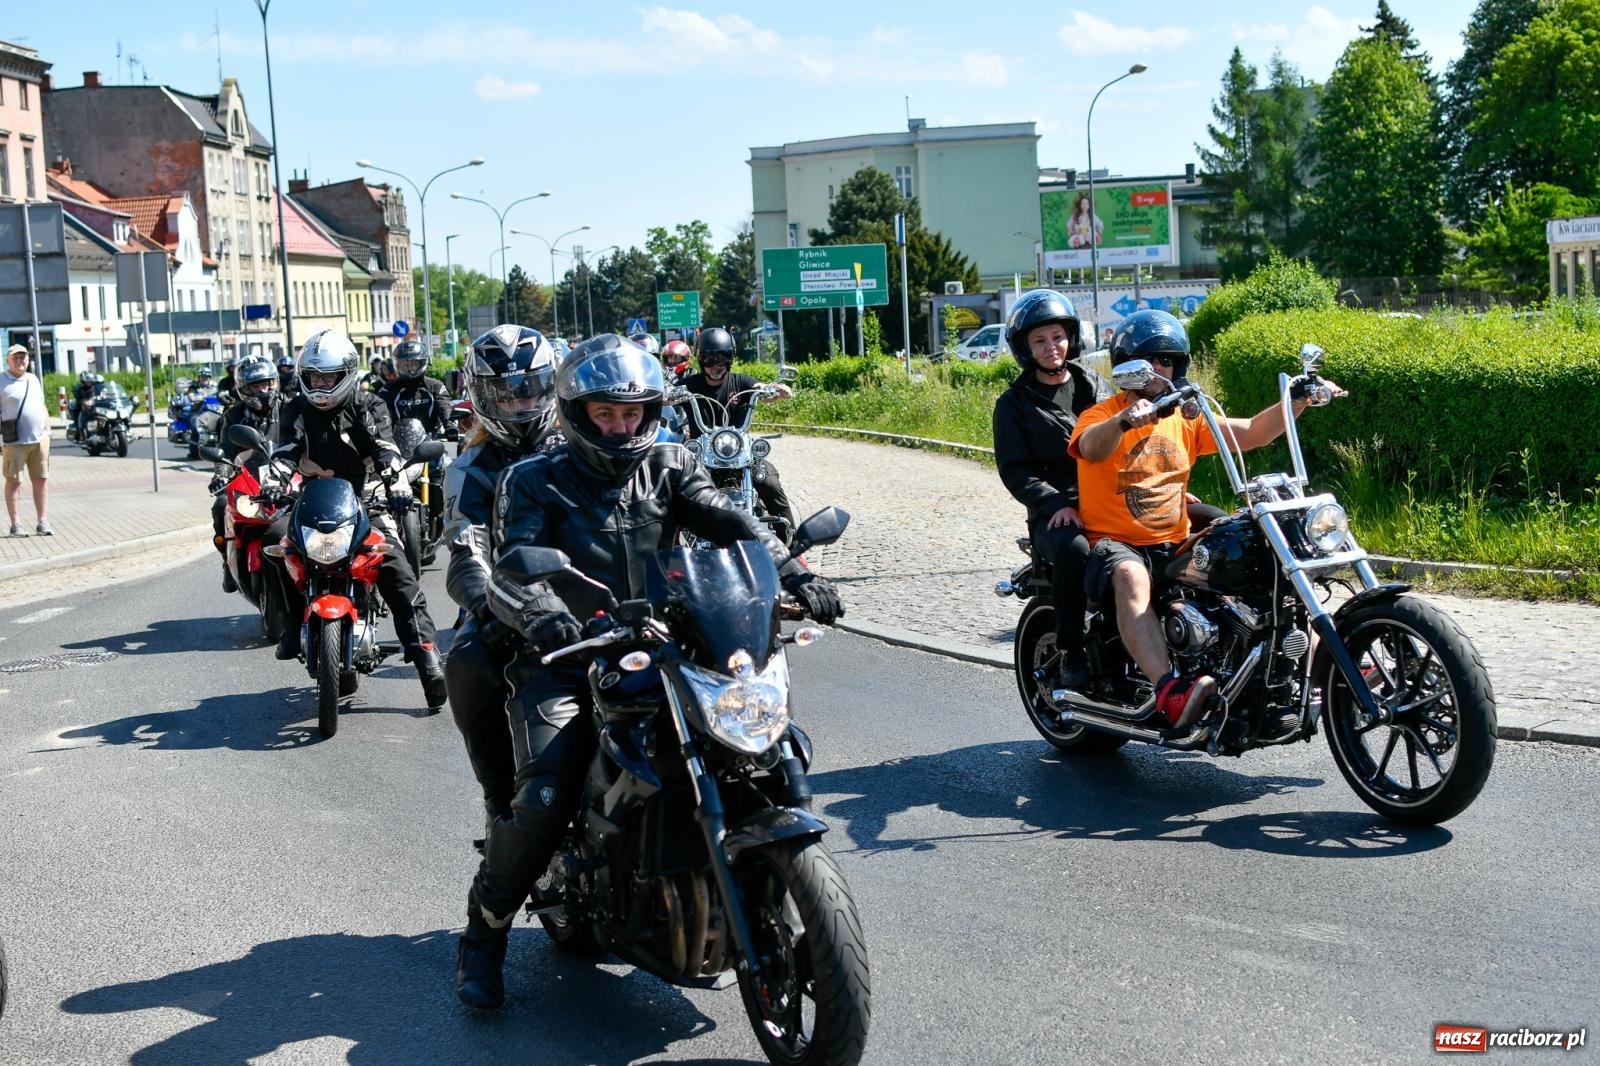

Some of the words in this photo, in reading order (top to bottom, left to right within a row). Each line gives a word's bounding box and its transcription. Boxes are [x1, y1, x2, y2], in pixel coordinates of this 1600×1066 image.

[799, 250, 827, 259] Rybnik
[799, 261, 831, 269] Gliwice
[824, 271, 849, 279] Miejski
[800, 296, 827, 306] Opole
[501, 369, 526, 377] SHARK
